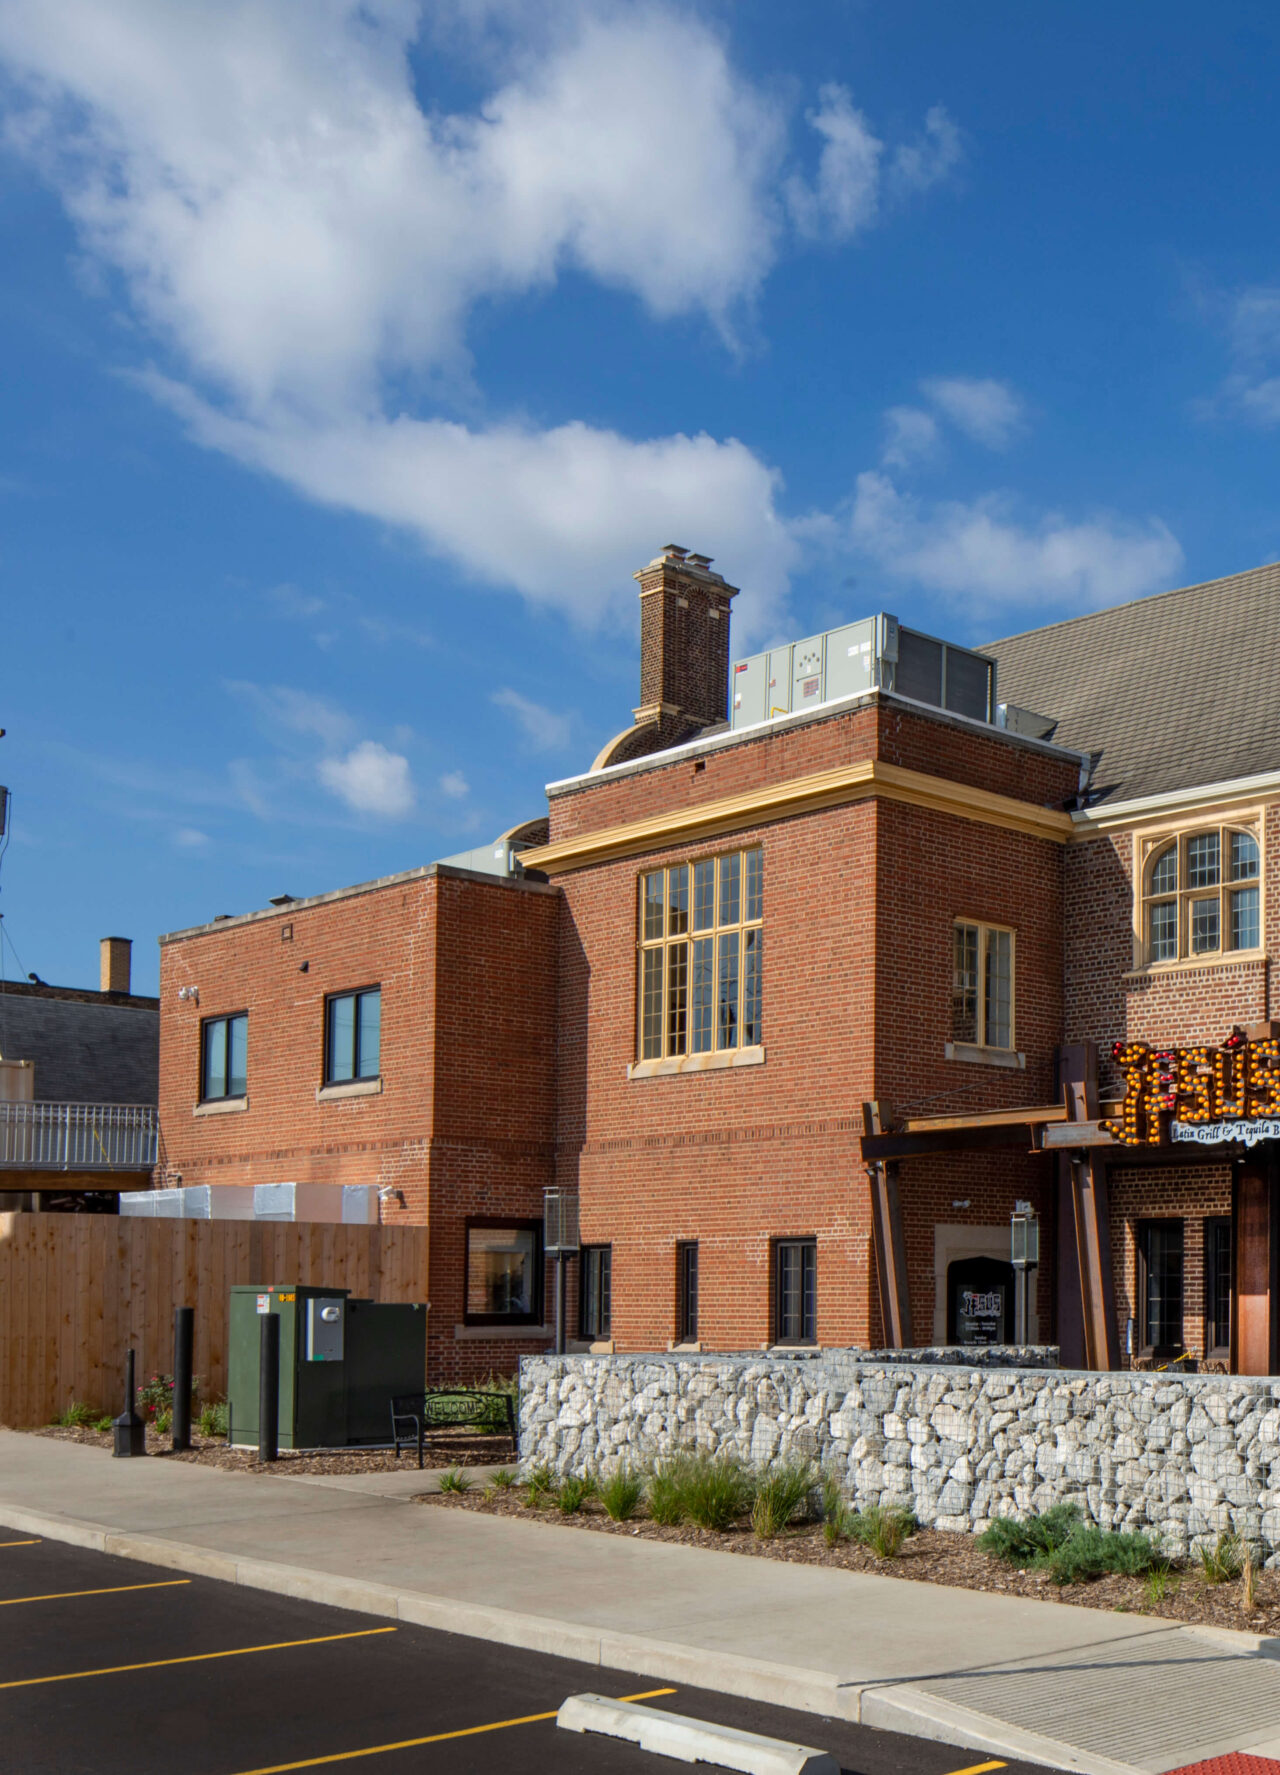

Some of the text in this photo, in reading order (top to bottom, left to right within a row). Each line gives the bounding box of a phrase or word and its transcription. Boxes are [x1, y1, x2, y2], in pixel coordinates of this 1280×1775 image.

[1172, 1124, 1194, 1139] Latin
[1197, 1126, 1220, 1140] Grill
[1223, 1126, 1232, 1135] &
[1236, 1121, 1269, 1141] Tequila
[424, 1402, 482, 1414] WELCOME
